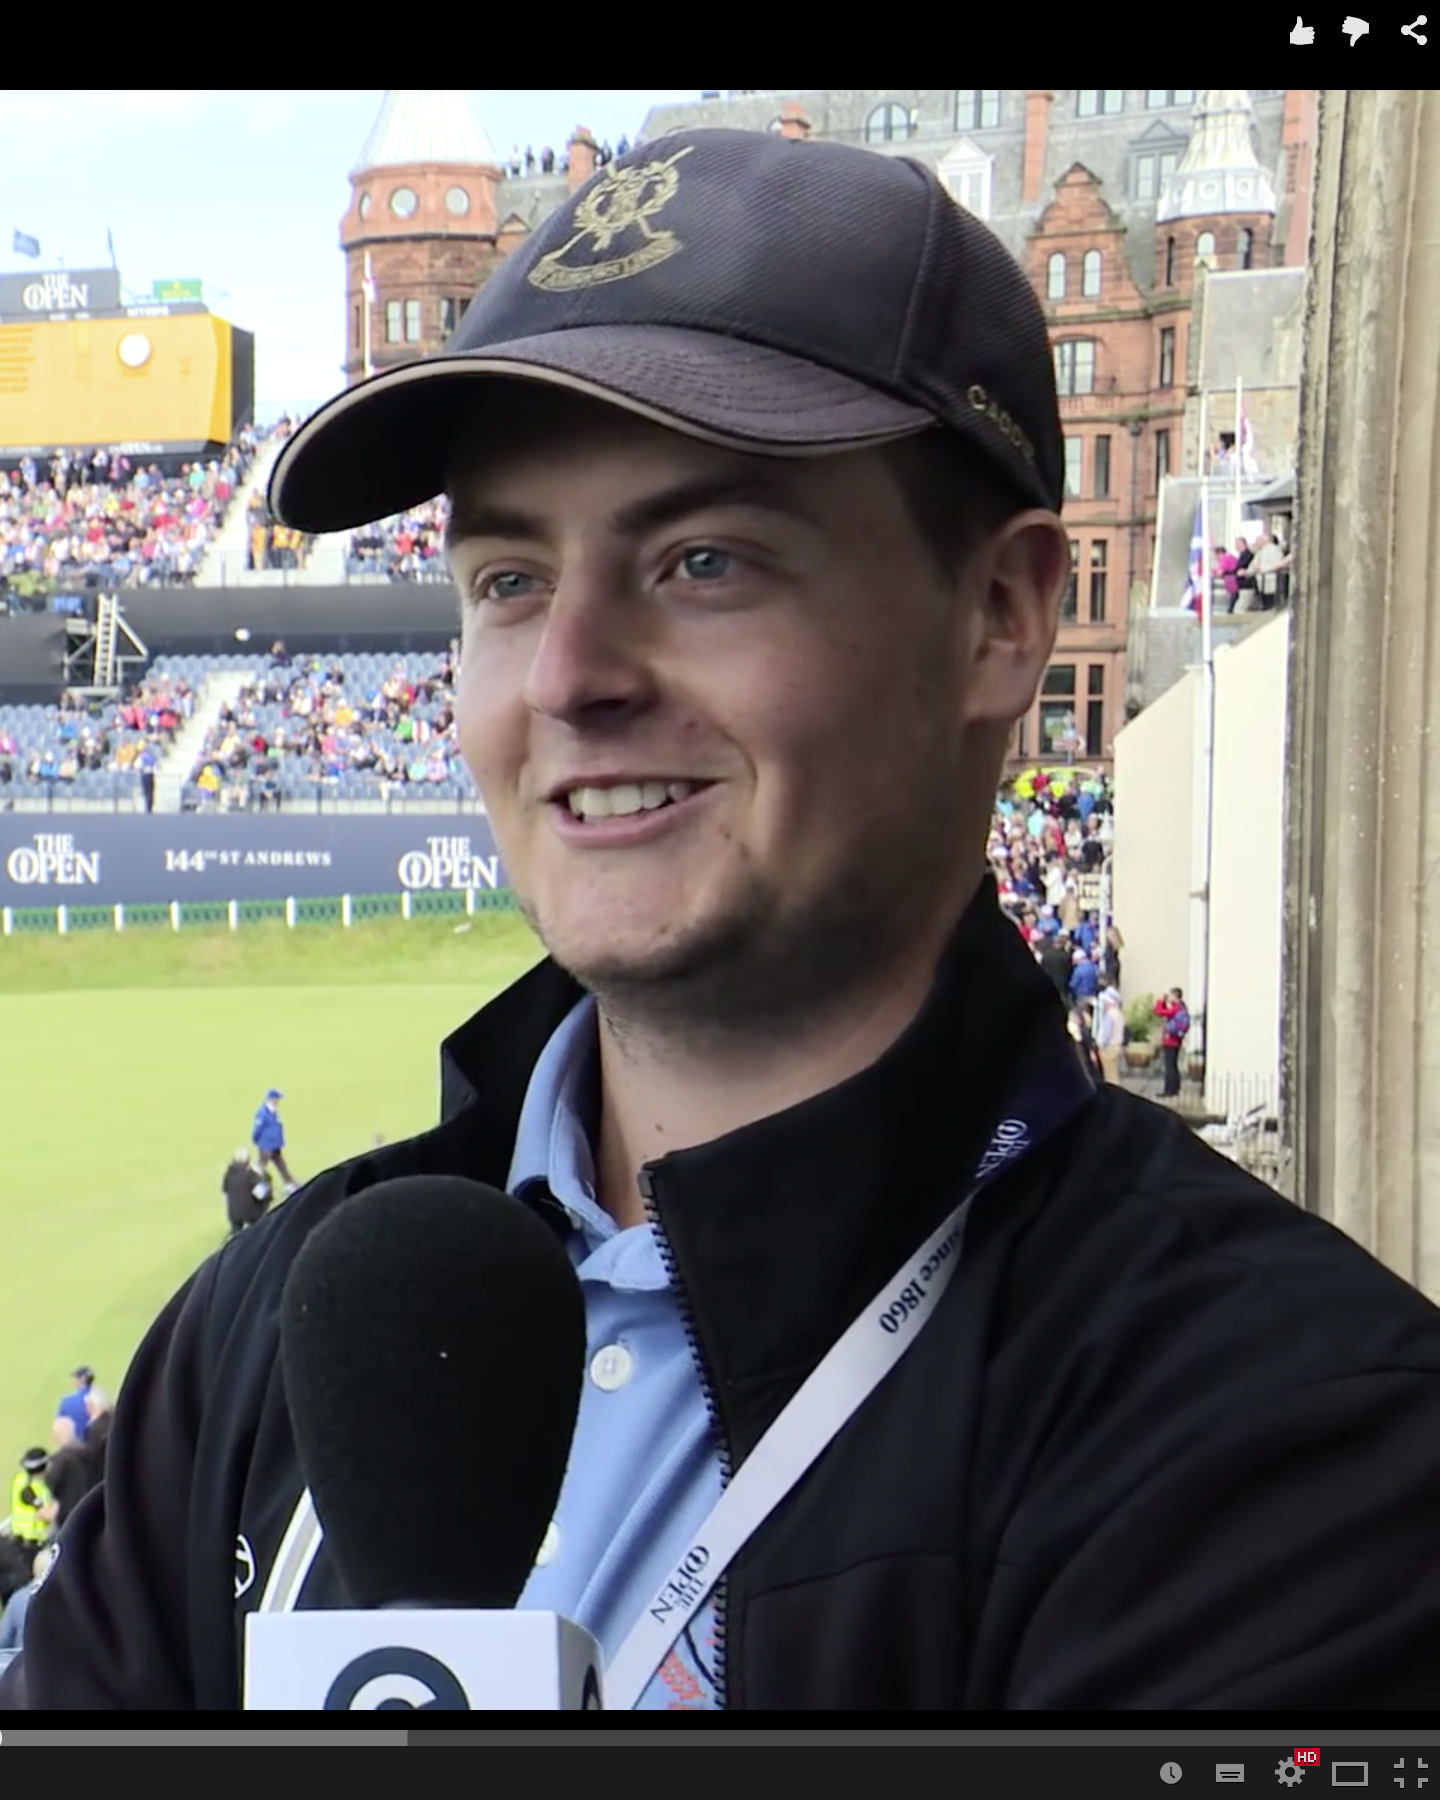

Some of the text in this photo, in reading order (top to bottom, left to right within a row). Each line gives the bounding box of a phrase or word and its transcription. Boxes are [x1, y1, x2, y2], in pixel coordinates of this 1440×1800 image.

[23, 282, 89, 311] OPEN
[34, 833, 74, 853] THE
[218, 850, 240, 866] ST
[244, 850, 332, 867] ANDREWS
[426, 836, 471, 857] THE
[7, 846, 100, 884] OPEN
[398, 850, 498, 890] OPEN
[878, 1278, 927, 1335] 1860
[650, 1544, 710, 1624] OPEN
